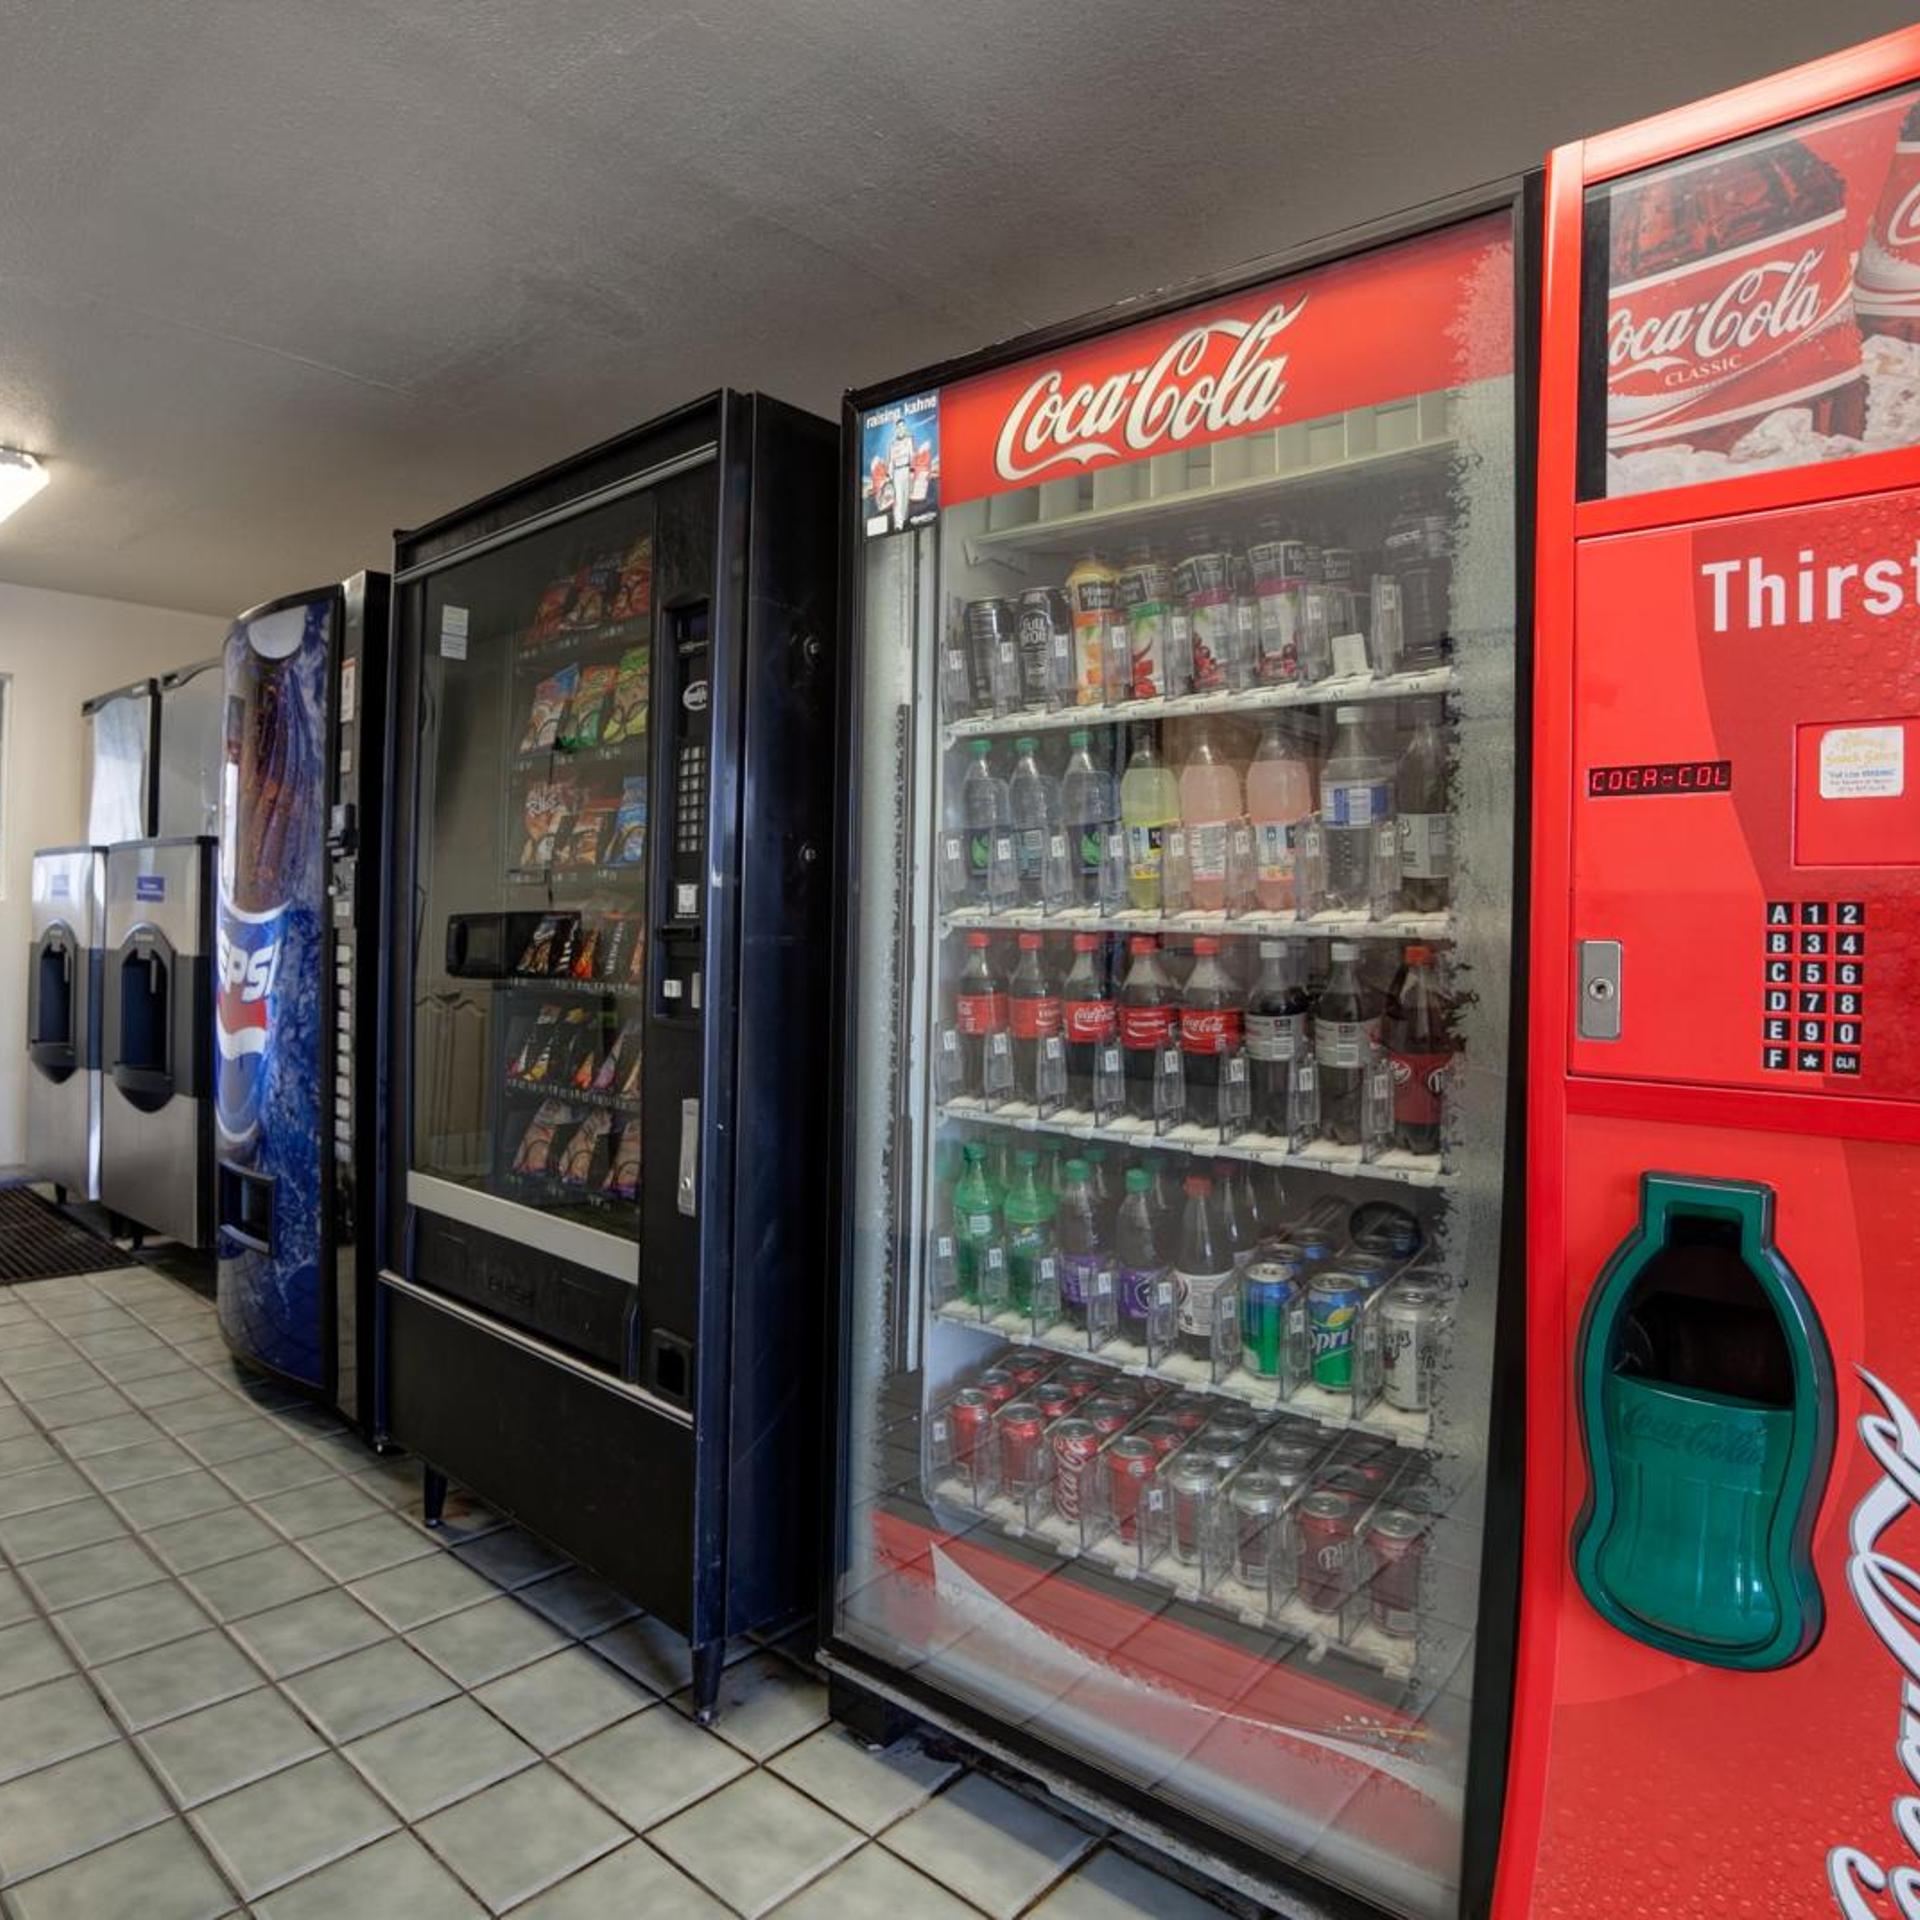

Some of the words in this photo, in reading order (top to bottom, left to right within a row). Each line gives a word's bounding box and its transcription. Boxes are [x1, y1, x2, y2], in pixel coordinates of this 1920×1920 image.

[1664, 354, 1743, 387] CLASSIC
[994, 293, 1309, 482] Coca-Cola
[1591, 766, 1730, 792] COCA-COL
[1772, 905, 1787, 923] A
[1808, 905, 1819, 923] 1
[1843, 905, 1857, 924] 2
[1772, 934, 1786, 952] B
[1807, 935, 1820, 953] 3
[1842, 935, 1856, 953] 4
[1771, 963, 1786, 981] C
[1806, 964, 1820, 982] 5
[1841, 965, 1855, 984] 6
[1771, 992, 1786, 1010] D
[1806, 993, 1819, 1011] 7
[1841, 995, 1854, 1013] 8
[1770, 1021, 1783, 1039] E
[1805, 1022, 1818, 1041] 9
[1840, 1024, 1853, 1043] 0
[1769, 1049, 1782, 1067] F
